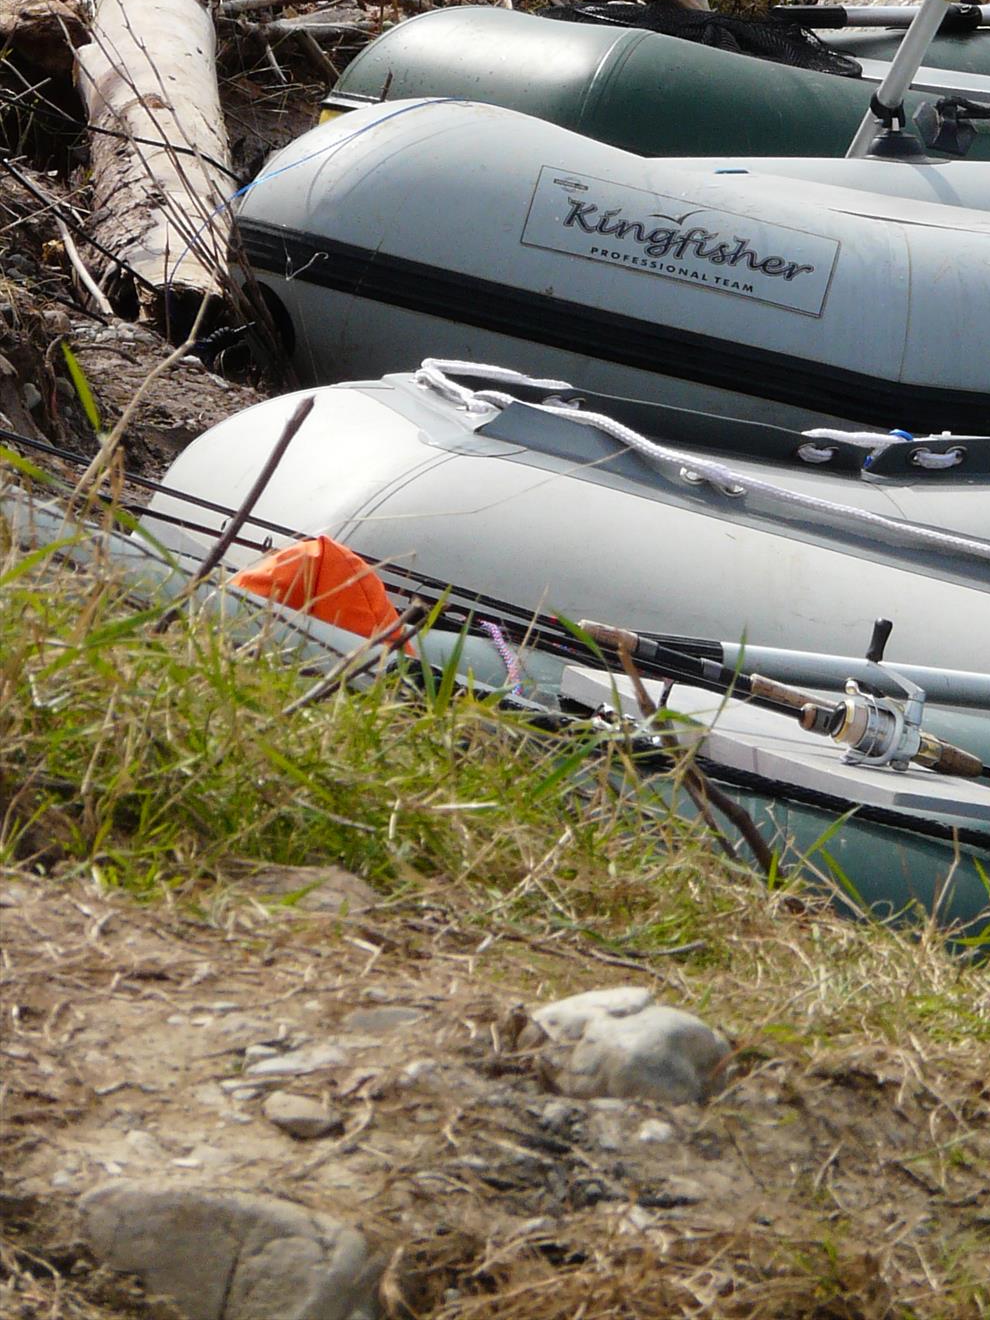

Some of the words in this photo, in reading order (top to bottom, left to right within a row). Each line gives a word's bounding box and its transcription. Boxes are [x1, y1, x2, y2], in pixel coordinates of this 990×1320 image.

[562, 196, 815, 282] Kingfisher
[590, 246, 709, 281] PROFESSIONAL
[714, 276, 754, 293] TEAM
